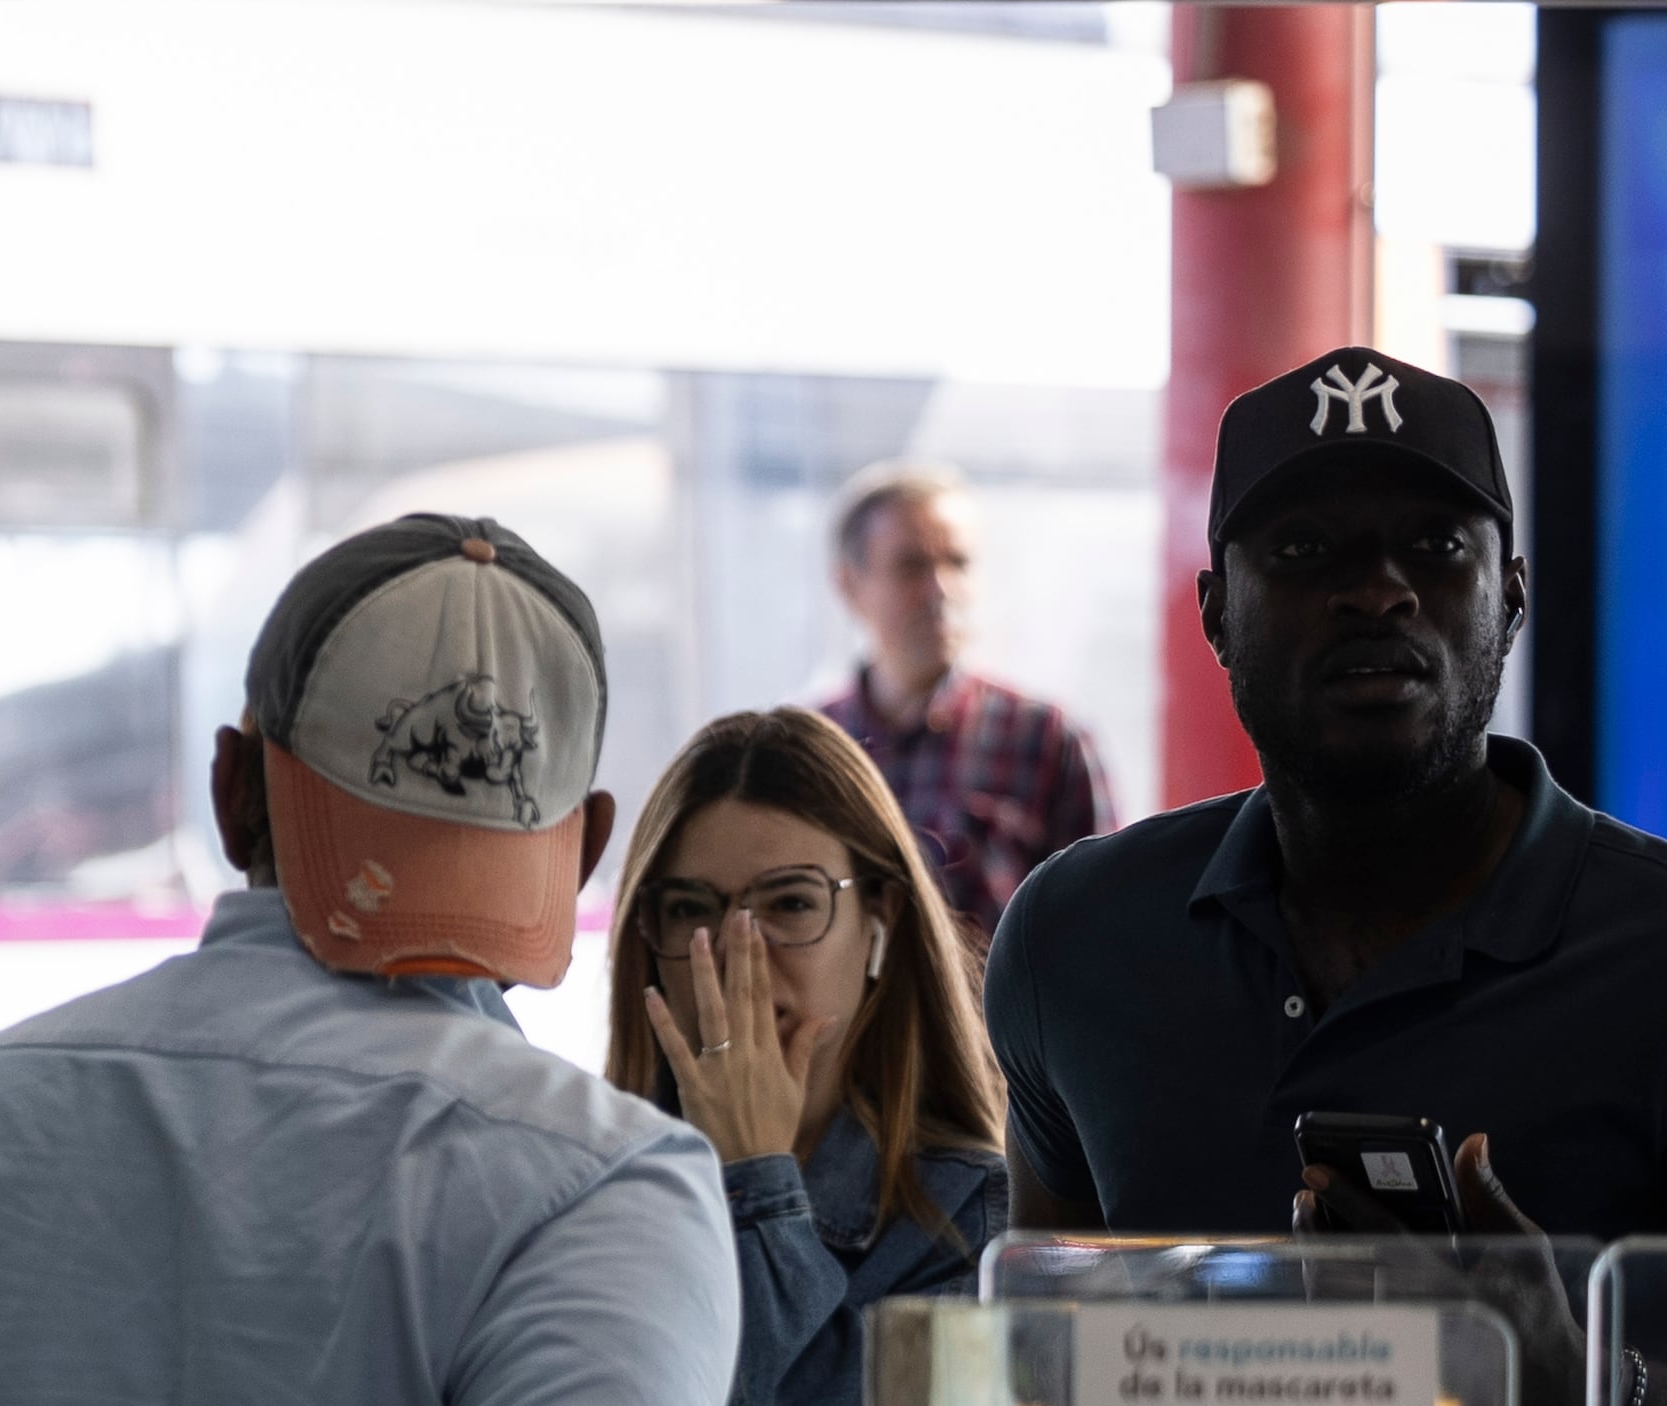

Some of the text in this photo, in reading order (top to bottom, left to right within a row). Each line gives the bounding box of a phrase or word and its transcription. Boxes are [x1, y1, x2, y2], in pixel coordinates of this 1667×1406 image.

[1123, 1321, 1393, 1366] Ús responsable
[1119, 1370, 1396, 1402] de la mascareta
